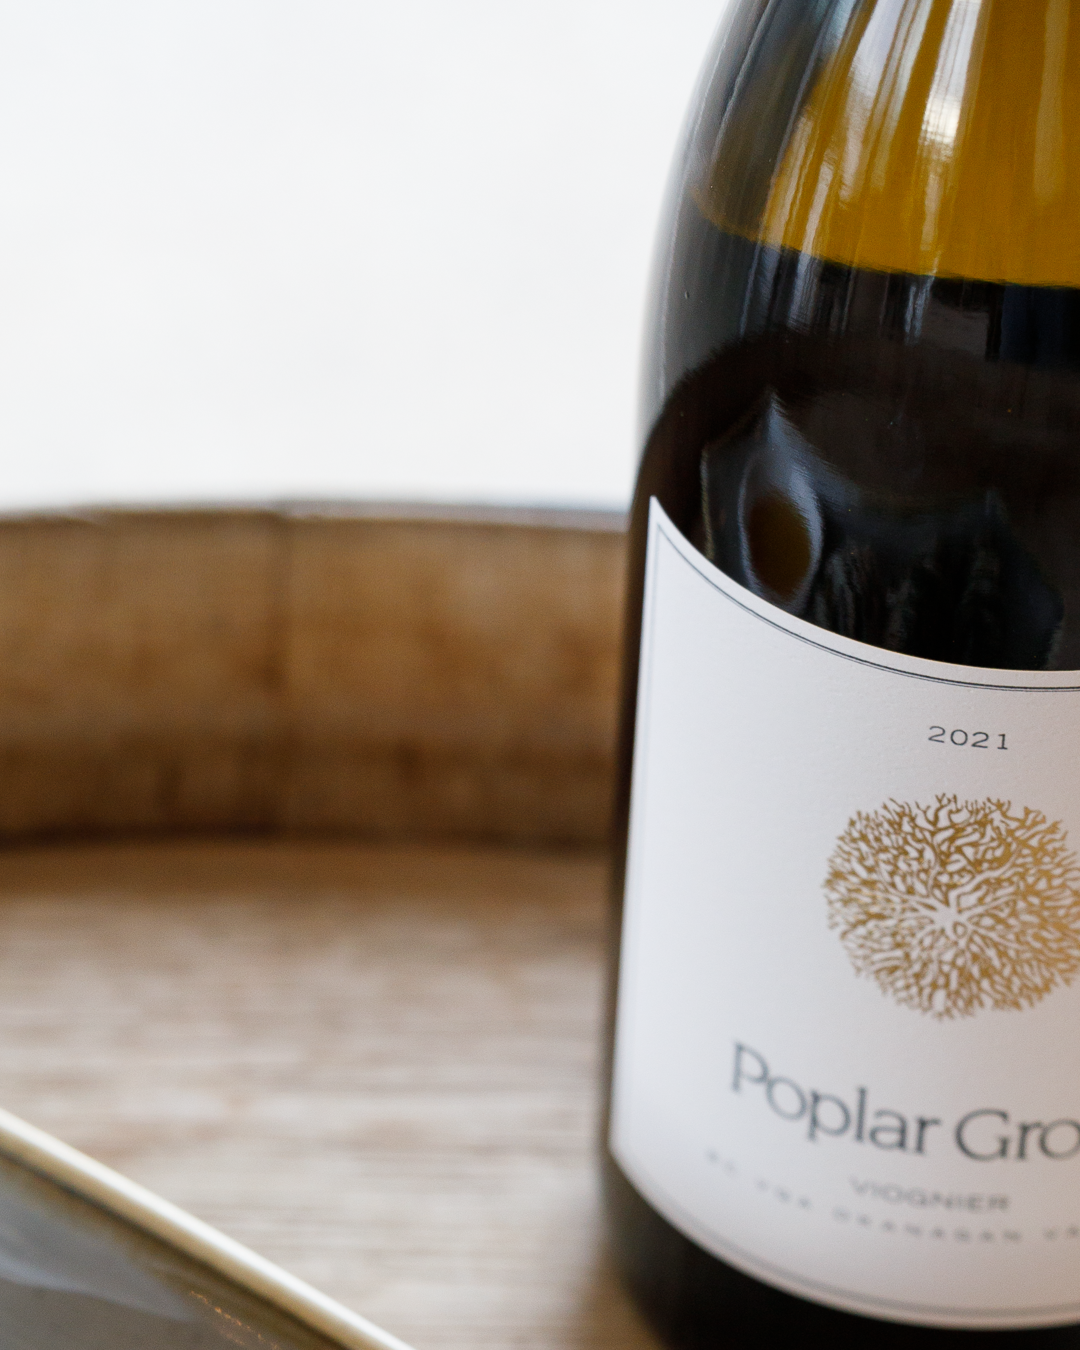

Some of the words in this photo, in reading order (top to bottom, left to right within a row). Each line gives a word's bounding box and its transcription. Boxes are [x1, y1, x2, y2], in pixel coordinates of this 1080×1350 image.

[928, 725, 1009, 751] 2021
[730, 1040, 942, 1154] Poplar
[954, 1108, 1080, 1161] Gro
